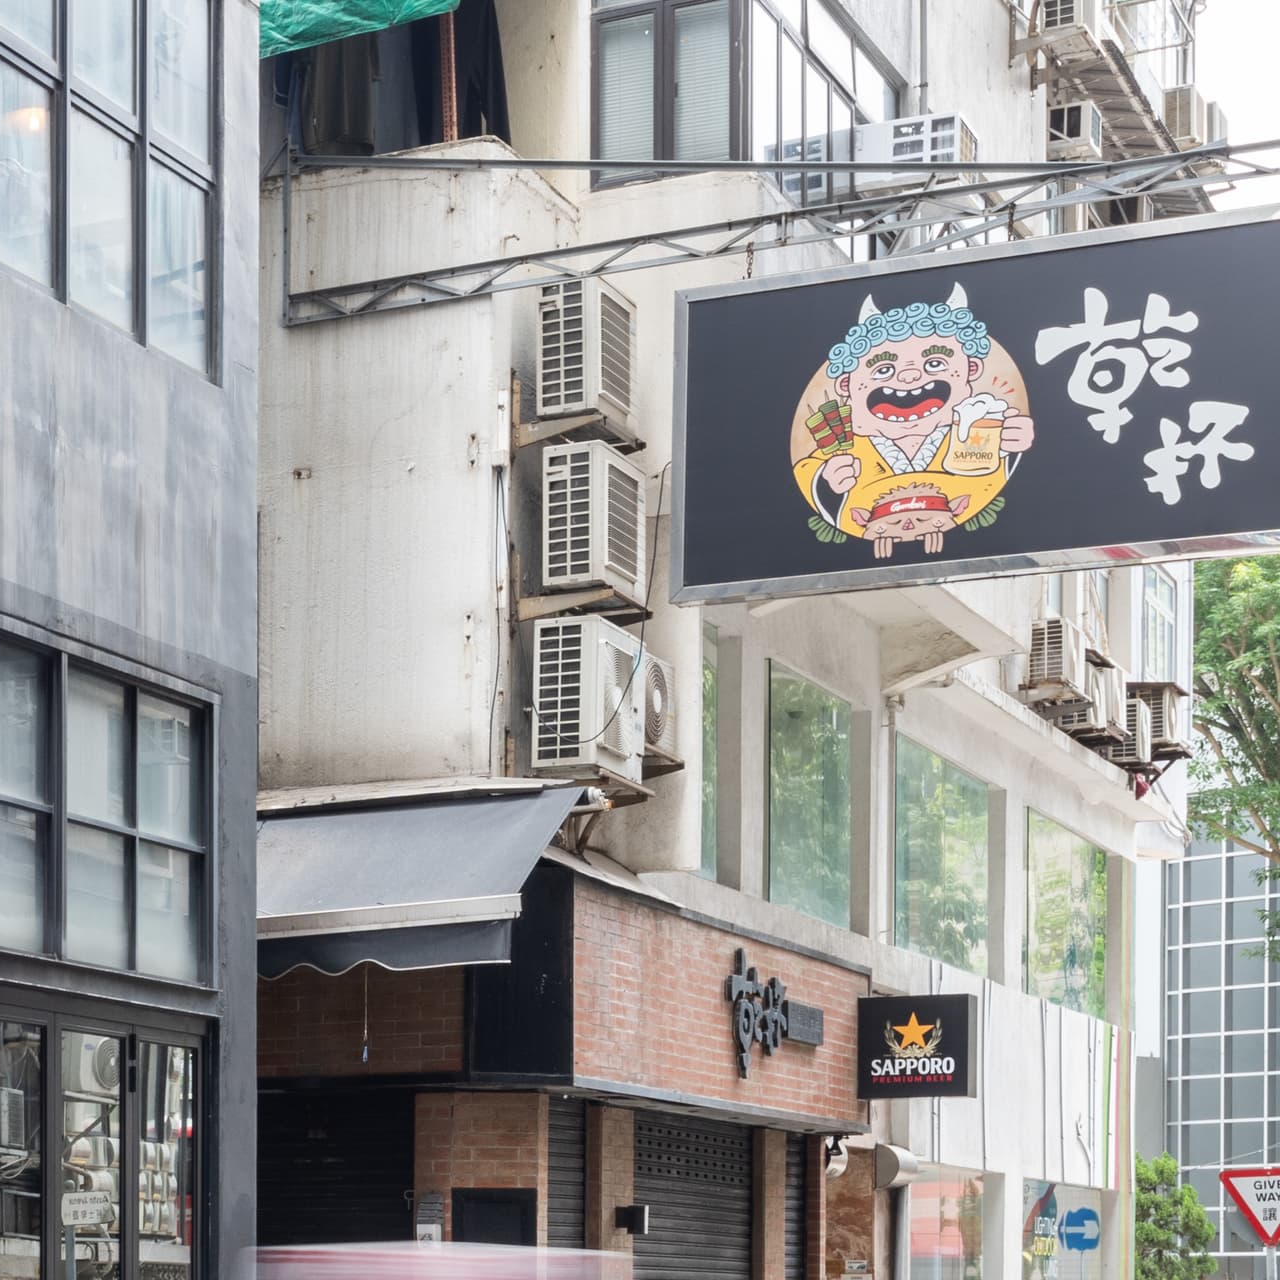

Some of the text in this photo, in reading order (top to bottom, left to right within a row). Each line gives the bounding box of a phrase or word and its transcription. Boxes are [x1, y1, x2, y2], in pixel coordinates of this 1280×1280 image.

[953, 451, 993, 461] SAPPORO
[871, 1056, 955, 1076] SAPPORO
[1253, 1180, 1280, 1190] GIVE
[1255, 1192, 1280, 1202] WAY
